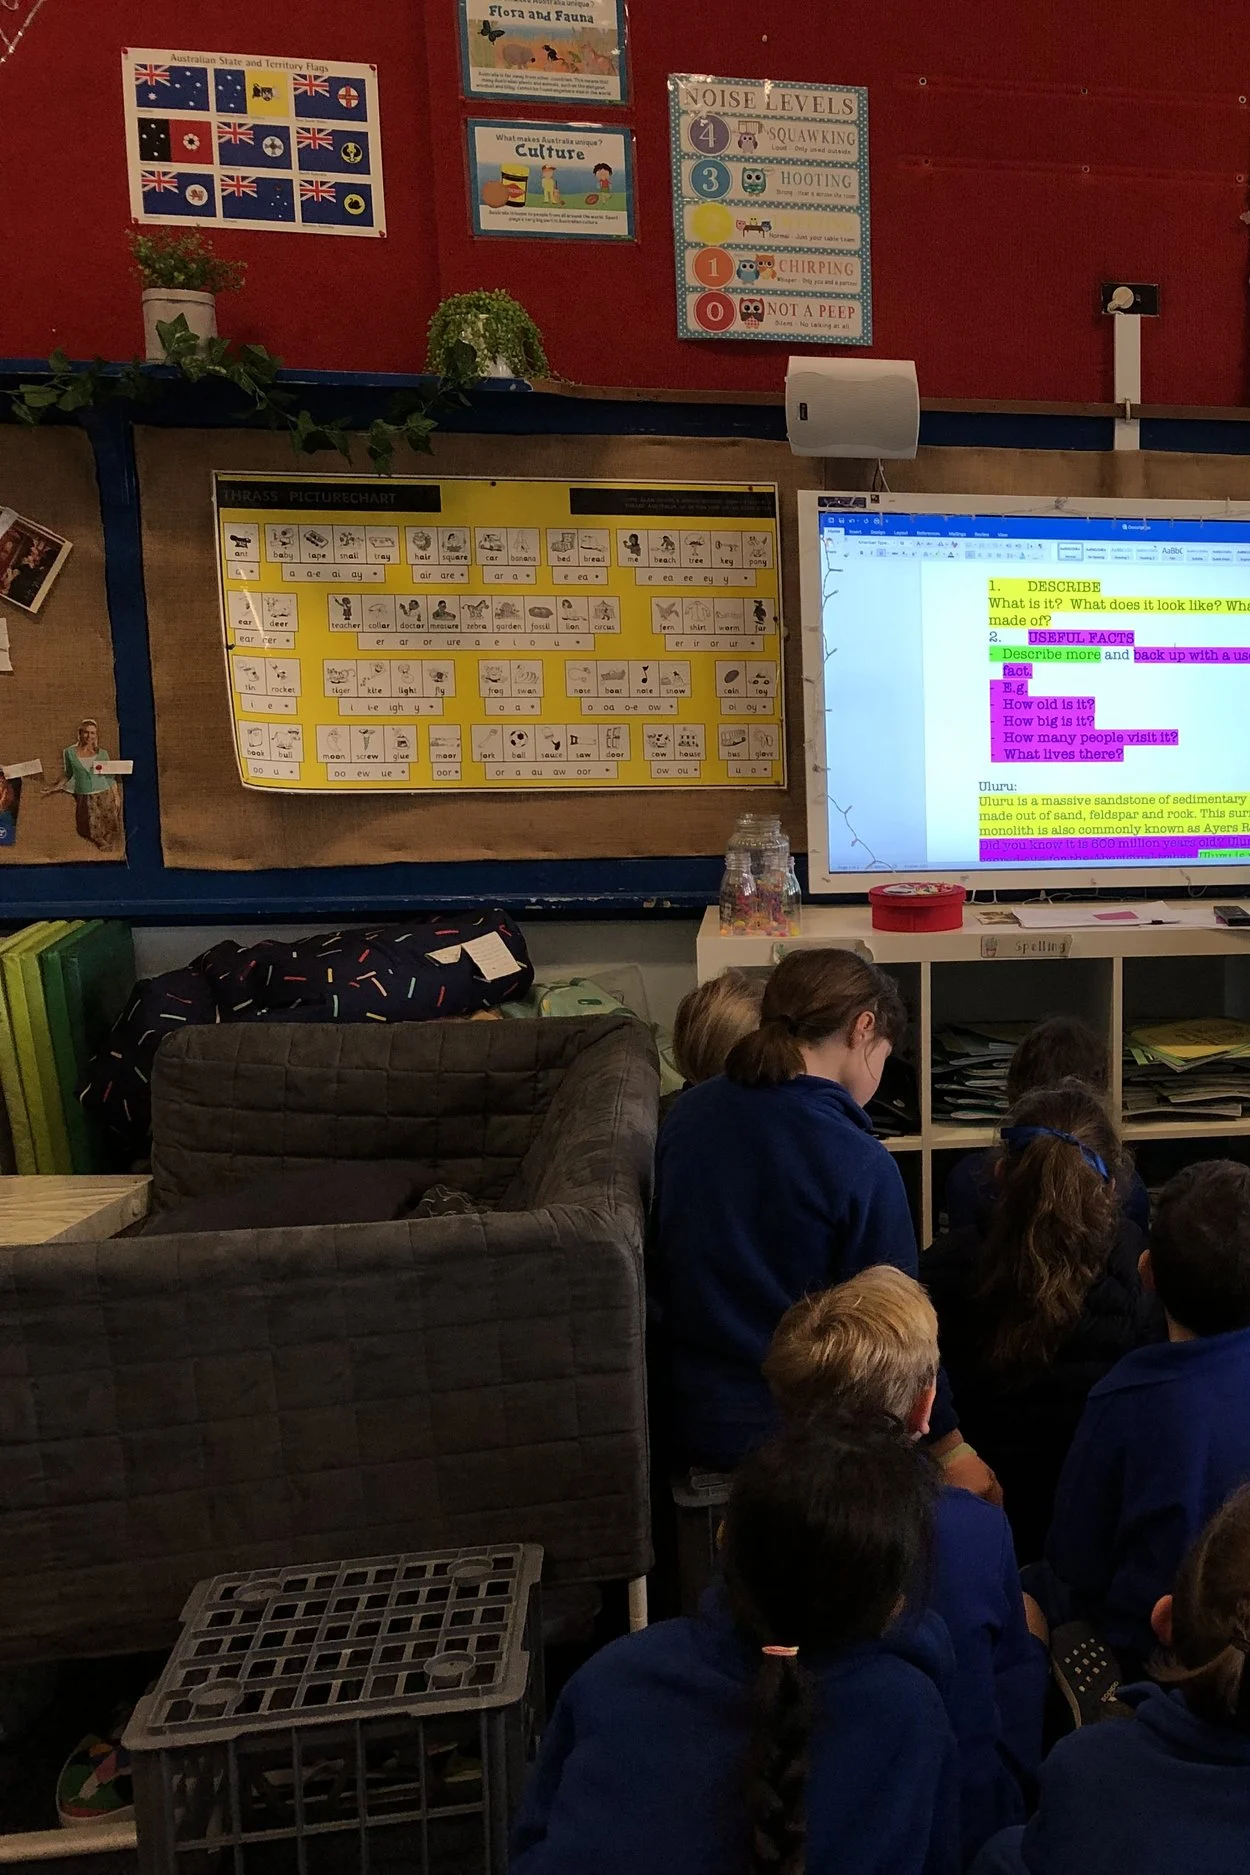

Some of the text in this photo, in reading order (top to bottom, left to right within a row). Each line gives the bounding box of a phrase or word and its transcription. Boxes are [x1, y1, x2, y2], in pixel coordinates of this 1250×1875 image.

[489, 5, 594, 23] Flora and Fauna
[171, 54, 328, 73] Australian State and Territory Flags
[685, 88, 854, 115] NOISE LEVELS
[542, 136, 573, 145] Australia
[700, 123, 716, 148] 4
[769, 127, 856, 145] SQUAWKING
[516, 144, 585, 160] Culture
[702, 168, 719, 191] 3
[781, 172, 851, 188] HOOTING
[708, 258, 719, 277] 1
[779, 260, 854, 276] CHIRPING
[767, 303, 855, 319] NOT A PEEP
[273, 551, 294, 560] baby
[308, 552, 327, 560] tape
[374, 553, 391, 561] tray
[990, 580, 1100, 592] 1. DESCRIBE
[988, 598, 1026, 609] What
[1028, 598, 1040, 610] is
[1044, 598, 1062, 610] it?
[1070, 599, 1106, 610] What
[1110, 599, 1140, 611] does
[1144, 599, 1154, 611] it
[1158, 599, 1186, 611] look
[1188, 600, 1222, 611] like?
[988, 614, 1052, 626] made of?
[988, 632, 1134, 644] 2. USEFUL FACTS
[1002, 649, 1062, 660] Describe
[1066, 652, 1100, 660] more
[1104, 649, 1130, 660] and
[1132, 649, 1166, 661] back
[1168, 652, 1186, 664] up
[1188, 649, 1218, 661] with
[1222, 652, 1230, 661] a
[1002, 665, 1032, 677] fact.
[1002, 682, 1028, 697] E.g.
[1002, 698, 1096, 710] How old is it?
[1002, 715, 1094, 730] How big is it?
[1002, 732, 1178, 747] How many people visit it?
[1004, 748, 1124, 760] What lives there?
[978, 781, 1016, 792] Uluru:
[978, 796, 1014, 806] Uluru
[1018, 795, 1028, 806] is
[1030, 798, 1038, 806] a
[1040, 795, 1092, 805] massive
[1094, 794, 1156, 805] sandstone
[1158, 794, 1170, 805] of
[1172, 794, 1248, 807] sedimentary
[978, 810, 1012, 821] made
[1016, 810, 1036, 820] out
[1038, 810, 1052, 820] of
[1054, 809, 1086, 821] sand,
[1090, 809, 1140, 822] feldspar
[1142, 809, 1164, 819] and
[1166, 808, 1196, 819] rock.
[1200, 808, 1226, 818] This
[978, 825, 1034, 836] monolith
[1038, 825, 1048, 835] is
[1052, 824, 1076, 835] also
[1078, 824, 1142, 837] commonly
[1144, 823, 1184, 834] known
[1202, 822, 1238, 836] Ayers
[980, 840, 999, 850] Did
[1003, 842, 1026, 851] you
[1030, 840, 1062, 849] know
[1066, 840, 1074, 848] it
[1078, 840, 1088, 848] is
[1092, 839, 1115, 848] 600
[1118, 837, 1159, 848] million
[1163, 840, 1195, 849] years
[1015, 939, 1067, 955] Spelling
